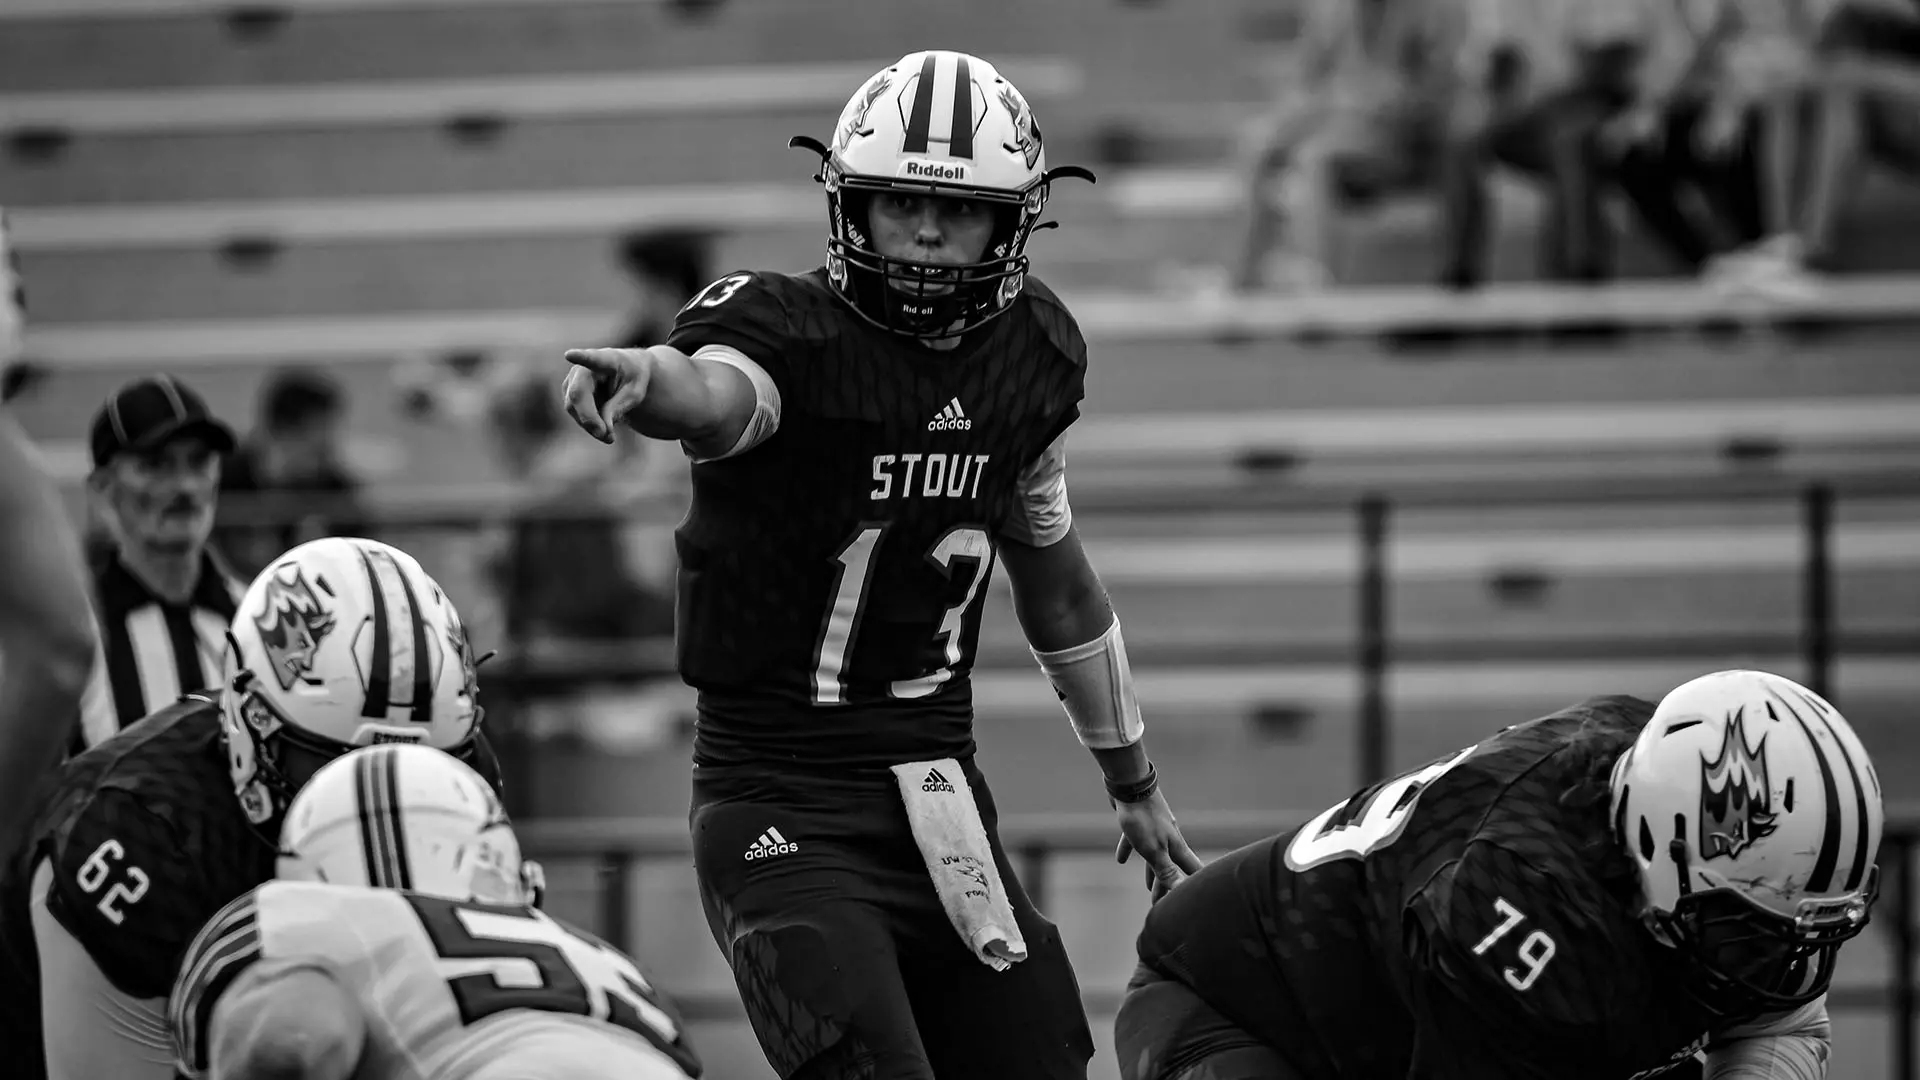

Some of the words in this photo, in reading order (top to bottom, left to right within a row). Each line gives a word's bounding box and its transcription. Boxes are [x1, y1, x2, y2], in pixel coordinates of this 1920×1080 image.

[907, 162, 965, 180] Riddell
[903, 304, 933, 315] Ridell
[928, 417, 972, 431] adidas
[870, 454, 990, 500] STOUT
[815, 527, 992, 704] 13
[921, 782, 956, 794] adidas
[744, 842, 799, 861] adidas
[77, 839, 149, 925] 62
[1472, 896, 1556, 991] 79
